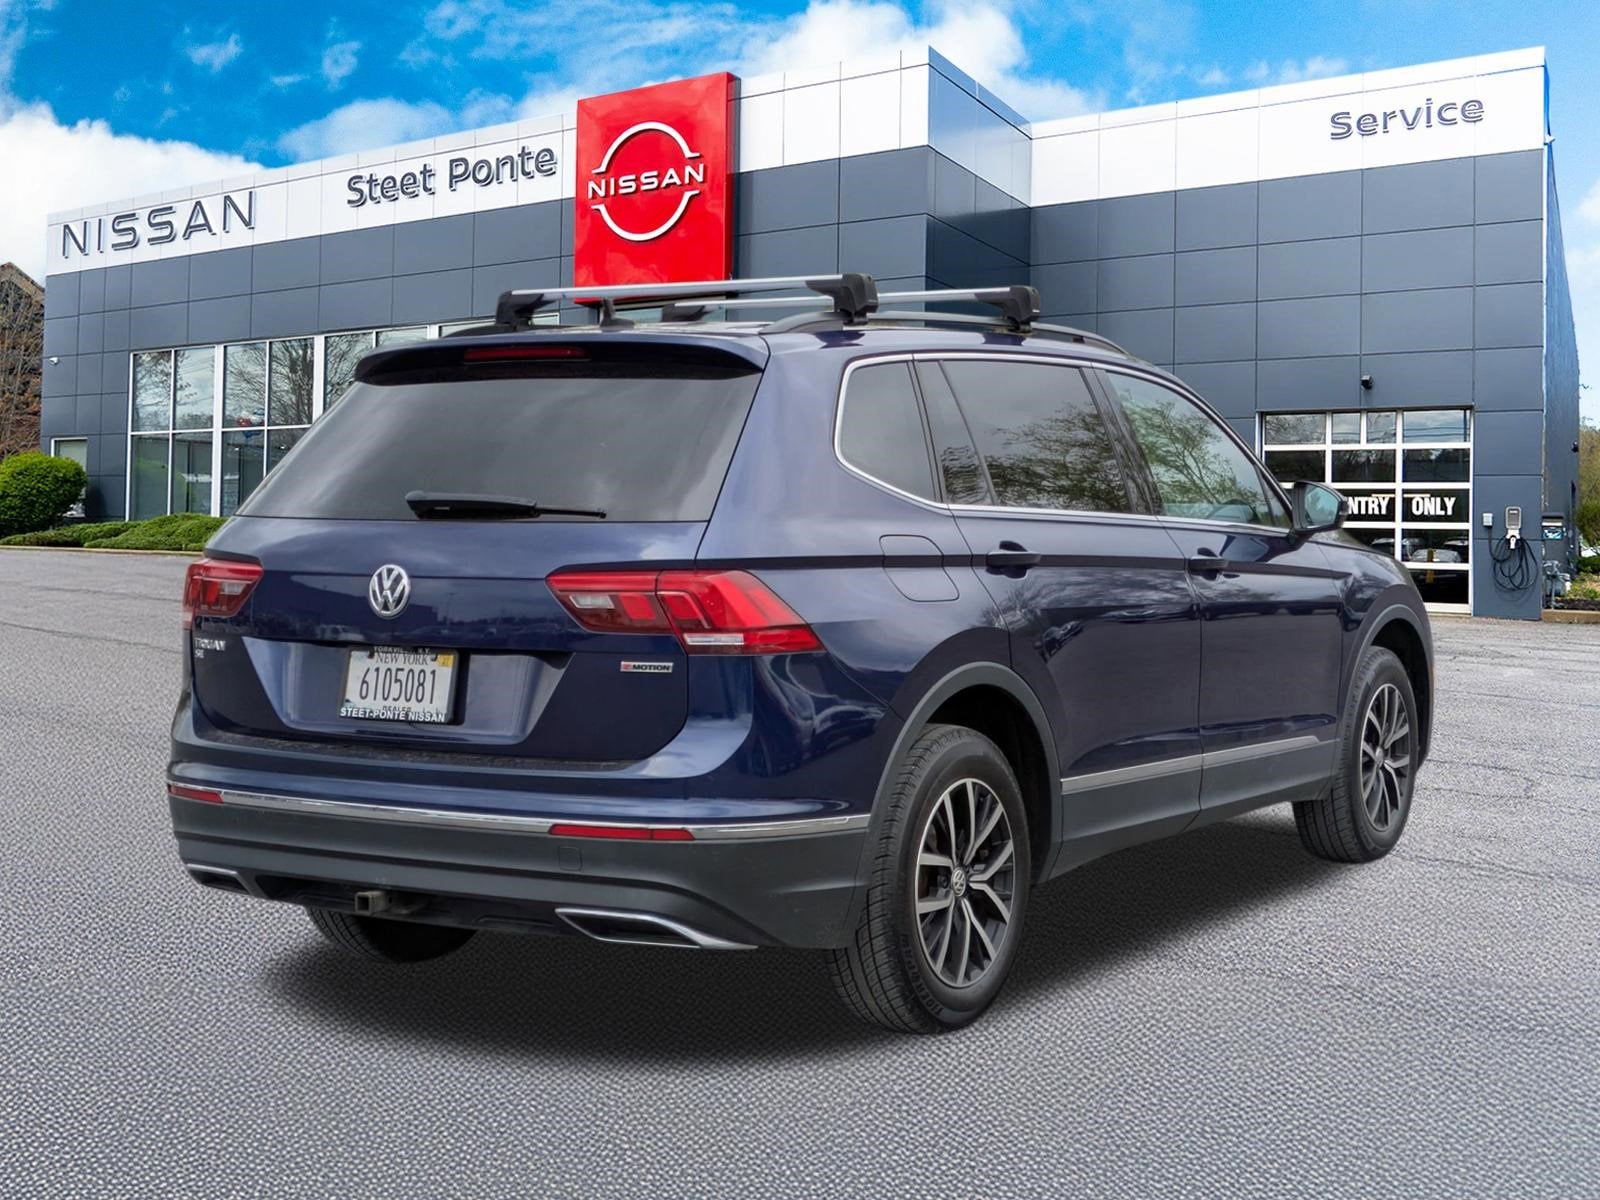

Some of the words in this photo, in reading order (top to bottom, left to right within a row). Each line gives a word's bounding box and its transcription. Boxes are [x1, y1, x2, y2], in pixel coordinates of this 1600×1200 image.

[1330, 98, 1485, 140] Service
[347, 162, 436, 208] Steet
[448, 146, 558, 192] Ponte
[587, 163, 705, 200] NISSAN
[62, 190, 256, 260] NISSAN
[1348, 496, 1390, 516] NTRY
[1411, 496, 1457, 517] ONLY
[375, 653, 398, 665] NEW
[402, 654, 430, 666] YORK
[360, 667, 437, 705] 6105081
[340, 707, 406, 720] STEET-PONTE
[408, 711, 445, 722] NISSAN
